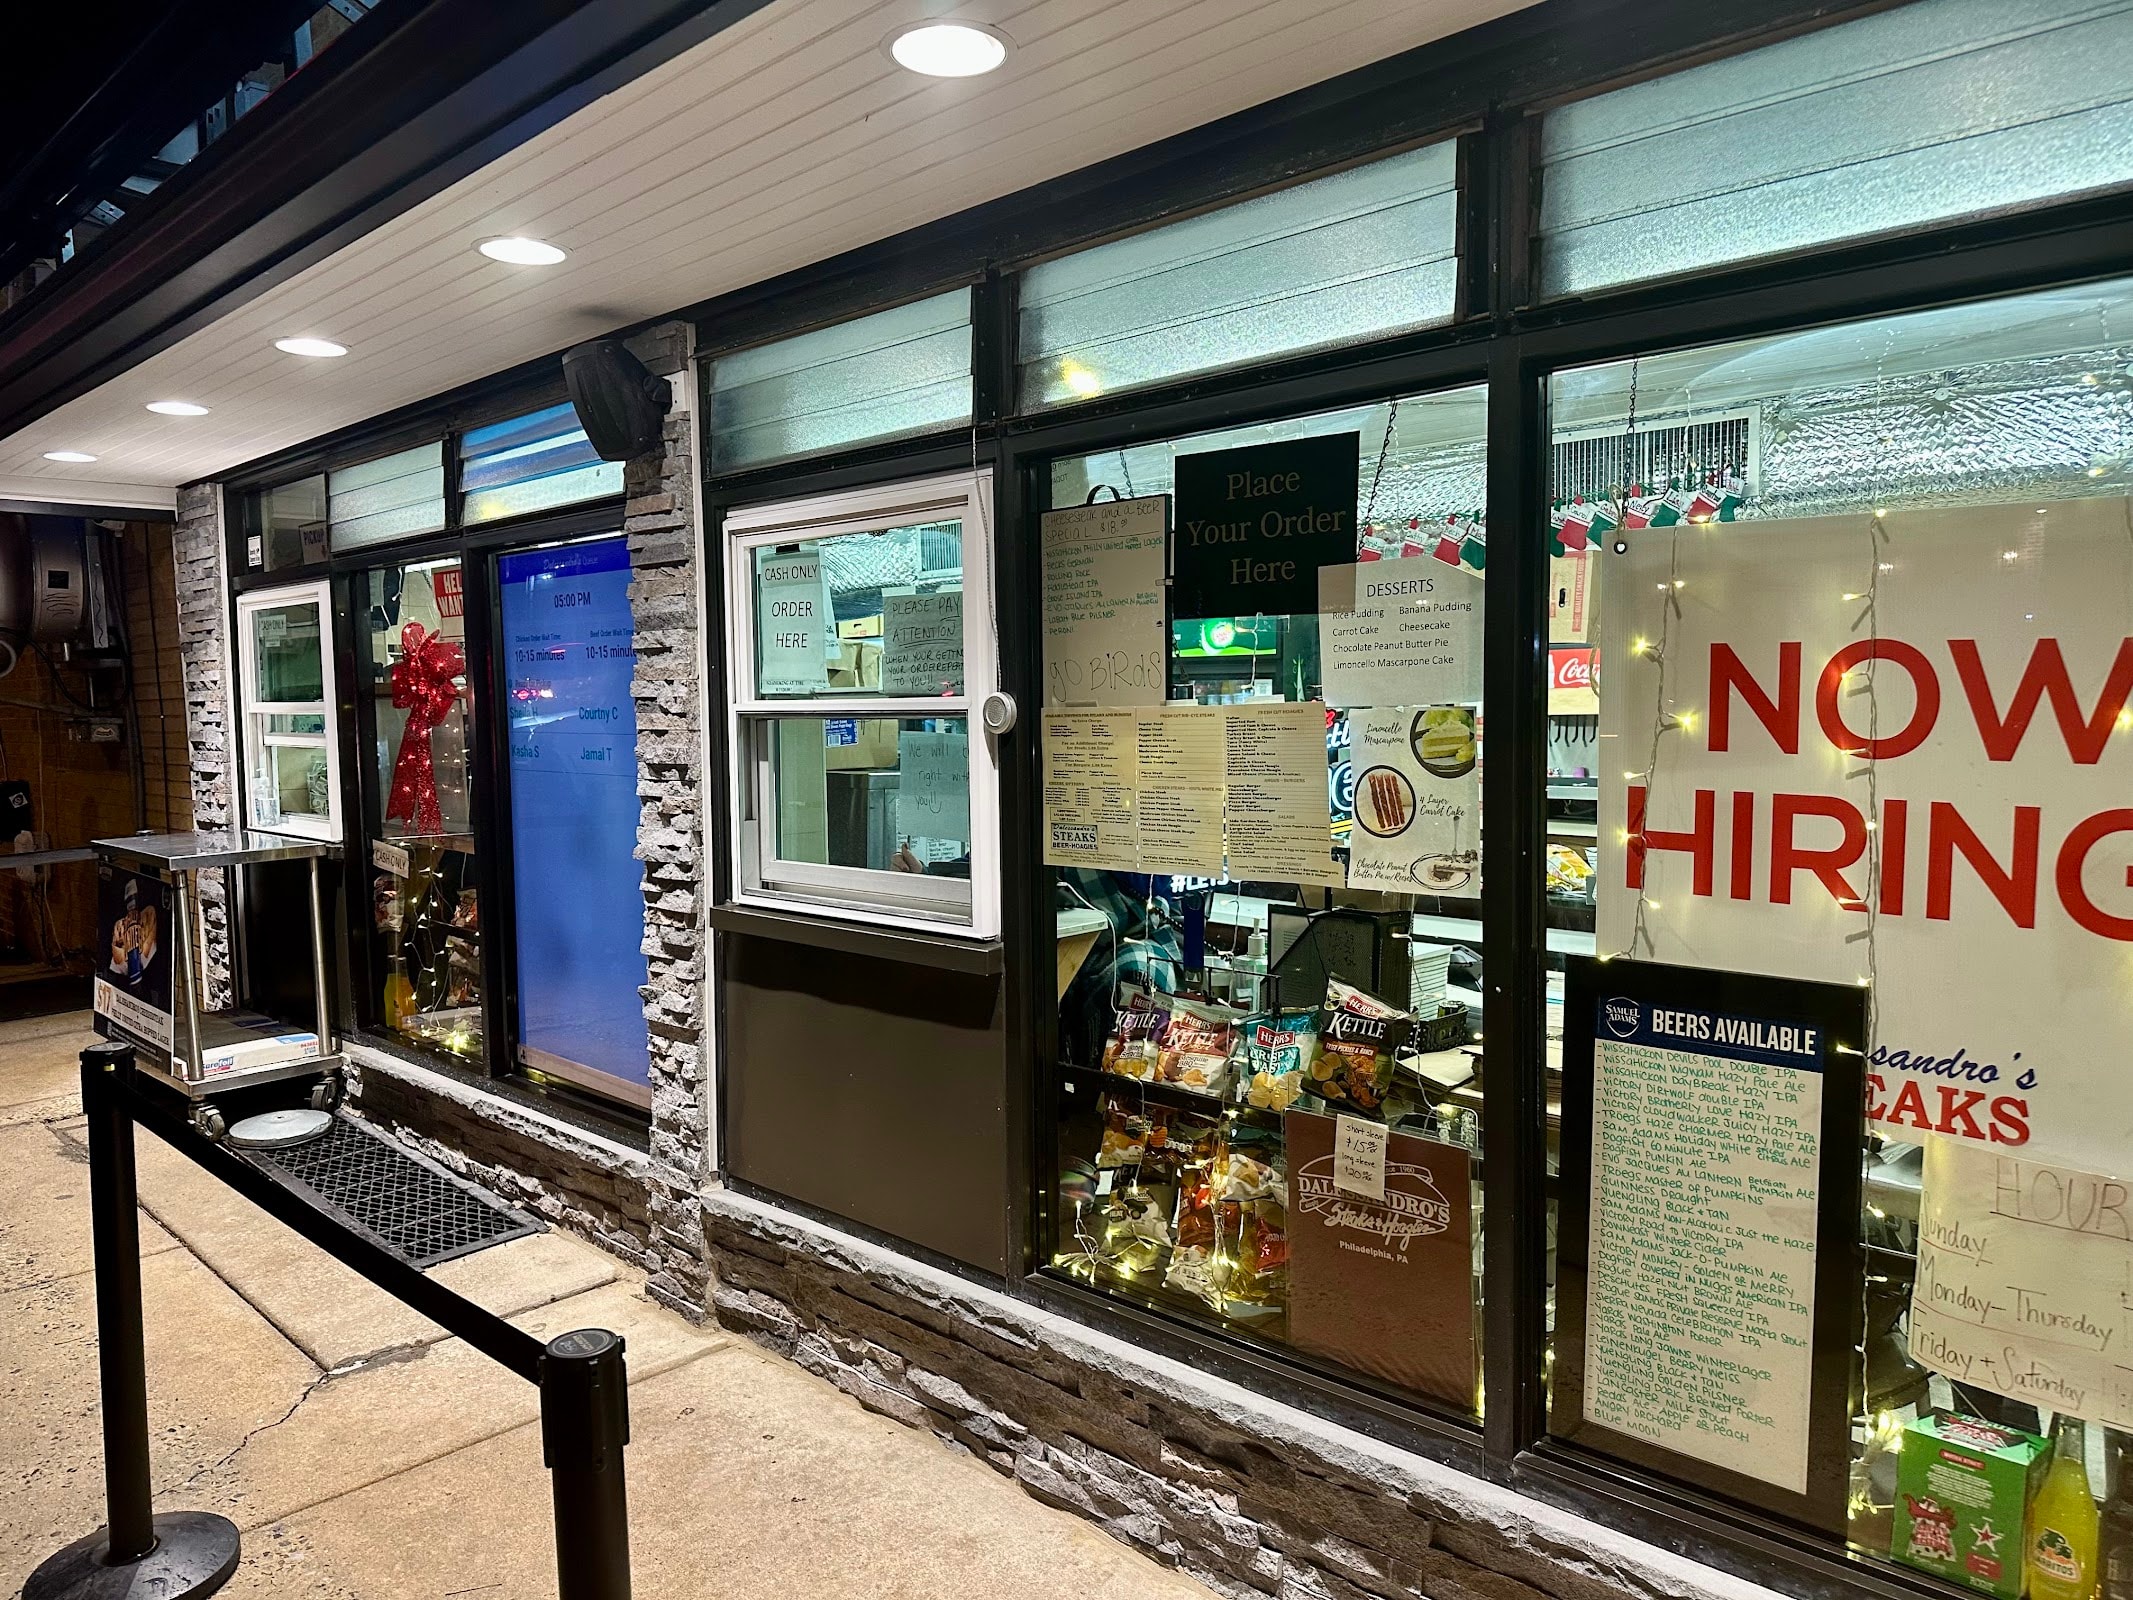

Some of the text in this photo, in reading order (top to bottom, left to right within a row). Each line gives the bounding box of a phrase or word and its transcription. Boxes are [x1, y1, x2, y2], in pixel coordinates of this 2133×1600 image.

[1226, 471, 1300, 500] Place
[1186, 520, 1251, 546] Your
[1261, 506, 1347, 539] Order
[303, 528, 324, 546] PICKUP
[765, 564, 818, 581] CASH ONLY
[1230, 558, 1296, 585] Here
[444, 573, 462, 594] HEL
[1366, 578, 1434, 597] DESSERTS
[554, 592, 591, 608] 05:00 PM
[892, 596, 960, 617] PLEASE PAY
[772, 601, 813, 617] ORDER
[1332, 602, 1471, 620] Rice Pudding Banana Pudding
[893, 622, 956, 642] ATTENTION
[1332, 620, 1451, 637] Carrot Cake Cheesecake
[776, 633, 808, 648] HERE
[1333, 638, 1449, 653] Chocolate Peanut Butter Pie
[515, 649, 565, 662] 10-15 minutes
[586, 646, 608, 659] 10-15
[886, 654, 908, 664] WHEN
[913, 650, 933, 661] YOUR
[1333, 655, 1454, 670] Limoncello Mascarpone Cake
[888, 665, 906, 678] YOUR
[893, 678, 904, 687] TO
[1707, 636, 2133, 765] NOW
[579, 707, 610, 723] Courtny
[612, 707, 618, 719] C
[534, 746, 540, 758] S
[580, 747, 605, 761] Jamal
[605, 748, 612, 760] T
[908, 742, 949, 758] We will
[918, 768, 942, 787] right
[1427, 794, 1449, 805] Layer
[1420, 805, 1465, 817] Carrot Cake
[1053, 832, 1096, 842] STEAKS
[375, 850, 388, 863] CASH
[1357, 858, 1385, 870] Chocolate
[1353, 870, 1375, 880] Butter
[1605, 1004, 1641, 1017] SAMUEL
[1325, 1012, 1387, 1040] KETTLE
[1608, 1013, 1638, 1026] ADAMS
[1652, 1009, 1817, 1055] BEERS AVAILABLE
[1774, 1067, 1797, 1079] IPA
[1743, 1099, 1765, 1111] IPA
[1773, 1090, 1798, 1104] IPA
[1346, 1126, 1384, 1141] short sleeve
[1342, 1152, 1376, 1168] long sleeve
[1650, 1139, 1662, 1150] 60
[1708, 1152, 1731, 1165] IPA
[1921, 1191, 1987, 1266] Sunday
[1339, 1240, 1408, 1264] Philadelphia, PA
[1724, 1238, 1744, 1250] IPA
[1911, 1306, 1972, 1379] Friday
[1993, 1346, 2085, 1410] Saturday
